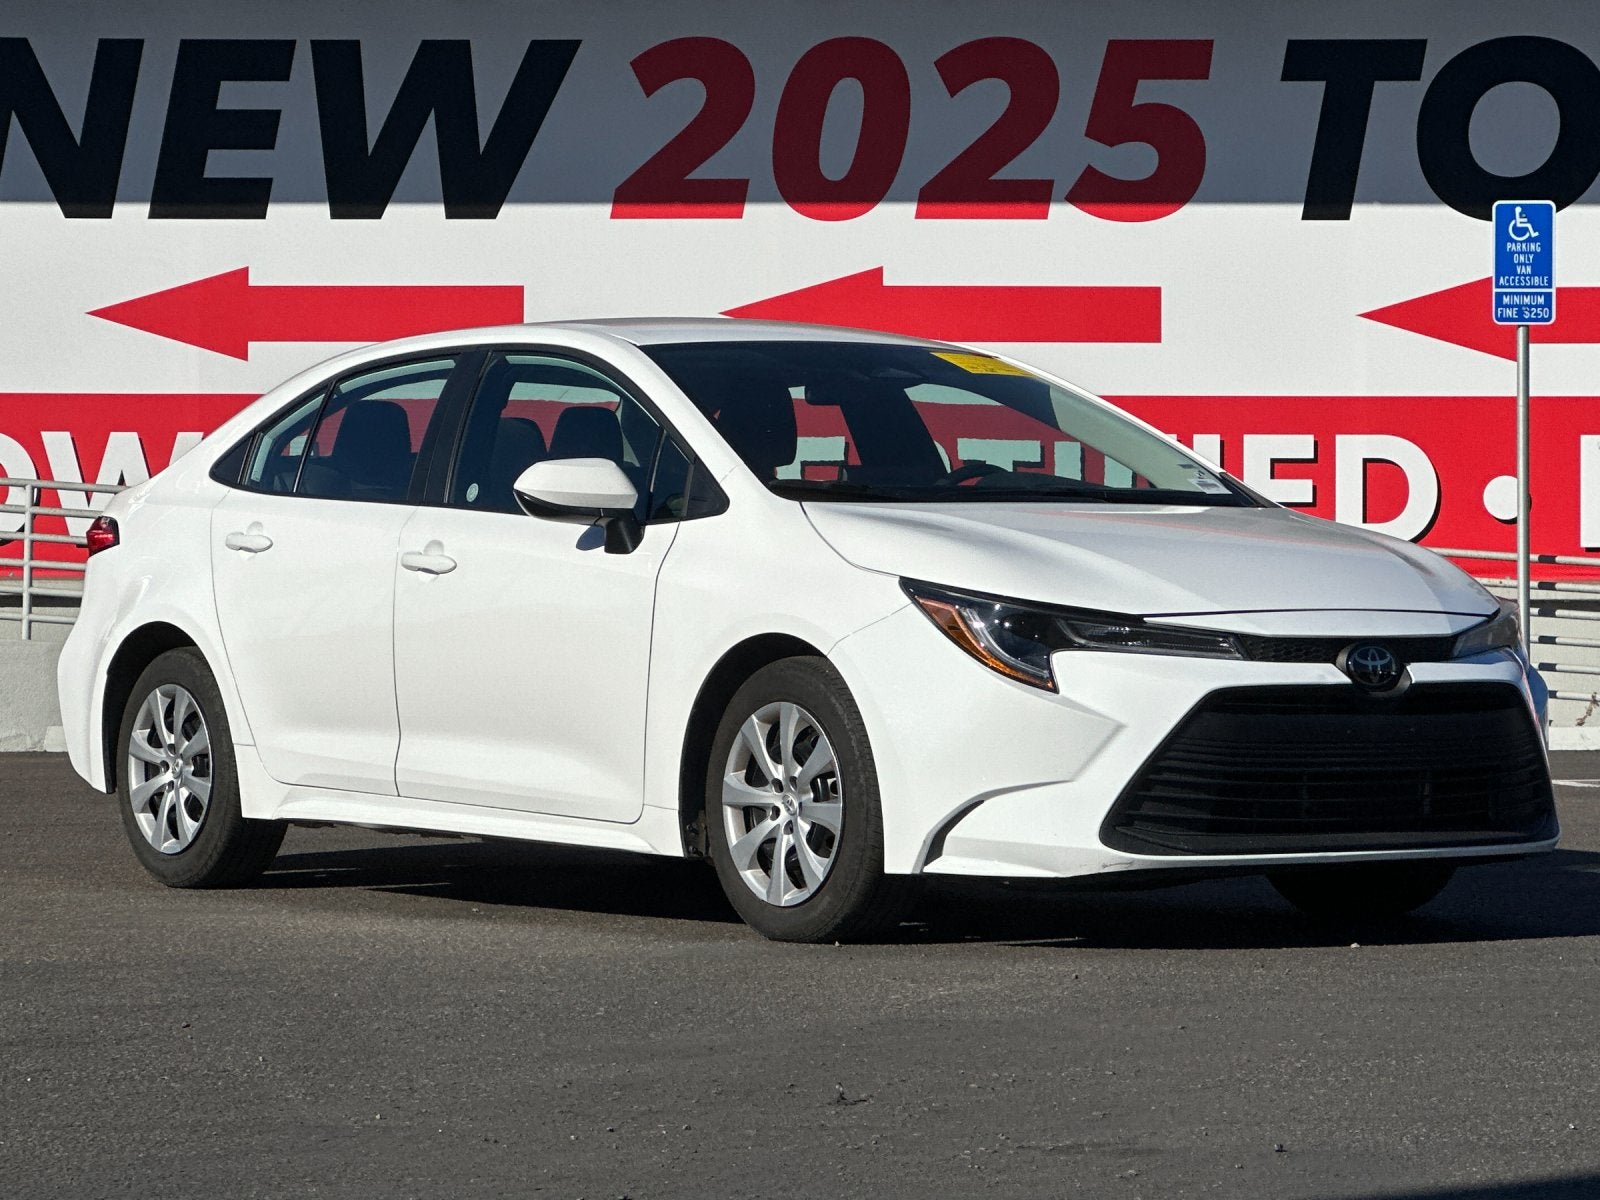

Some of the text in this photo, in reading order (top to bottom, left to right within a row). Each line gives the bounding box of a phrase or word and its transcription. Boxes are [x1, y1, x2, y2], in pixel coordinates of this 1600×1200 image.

[0, 35, 1600, 223] NEW 2025 TO
[1506, 242, 1541, 252] PARKING
[1513, 254, 1534, 264] ONLY
[1516, 265, 1532, 275] VAN
[1498, 276, 1549, 286] ACCESSIBLE
[1502, 294, 1545, 305] MINIMUM
[1497, 307, 1519, 318] FINE
